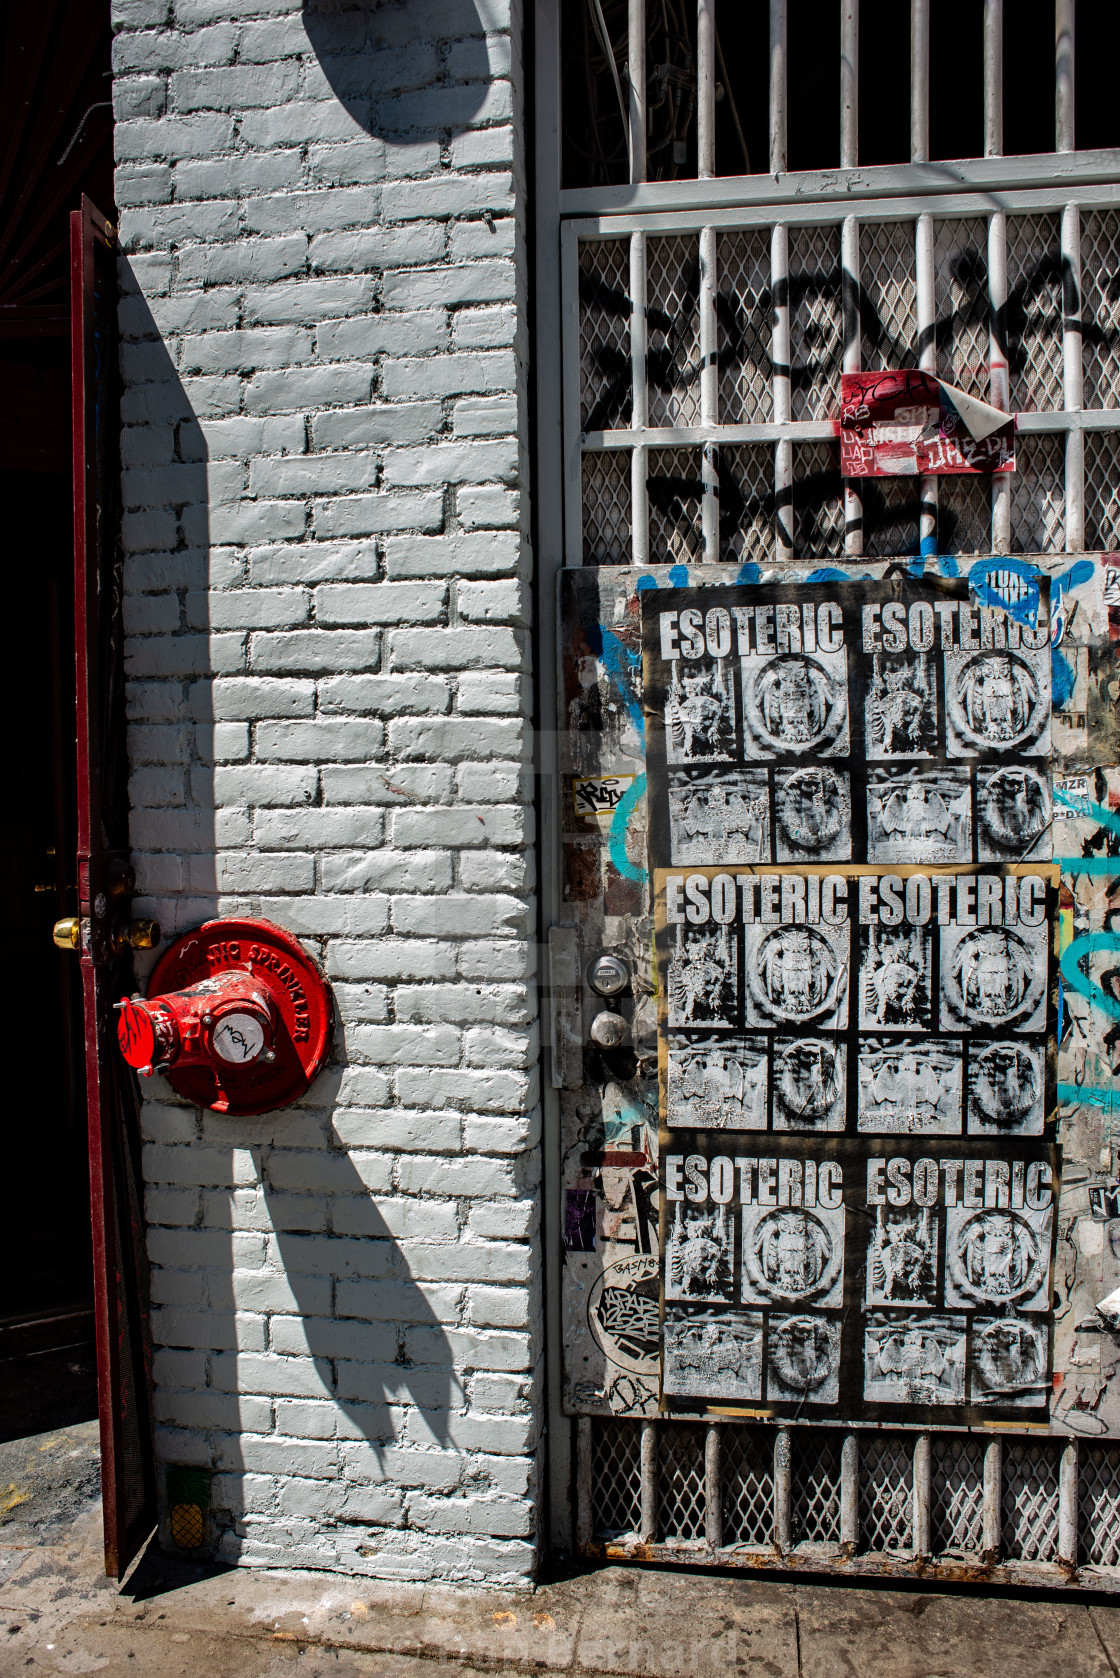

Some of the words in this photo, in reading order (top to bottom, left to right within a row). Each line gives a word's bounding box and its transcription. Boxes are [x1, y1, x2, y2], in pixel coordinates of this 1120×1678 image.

[659, 601, 845, 660] ESOTERIC
[665, 873, 851, 926] ESOTERIC
[858, 872, 1048, 927] ESOTERIC
[248, 944, 311, 1044] SPRINKLER
[665, 1154, 845, 1209] ESOTERIC
[865, 1156, 1055, 1210] ESOTERIC
